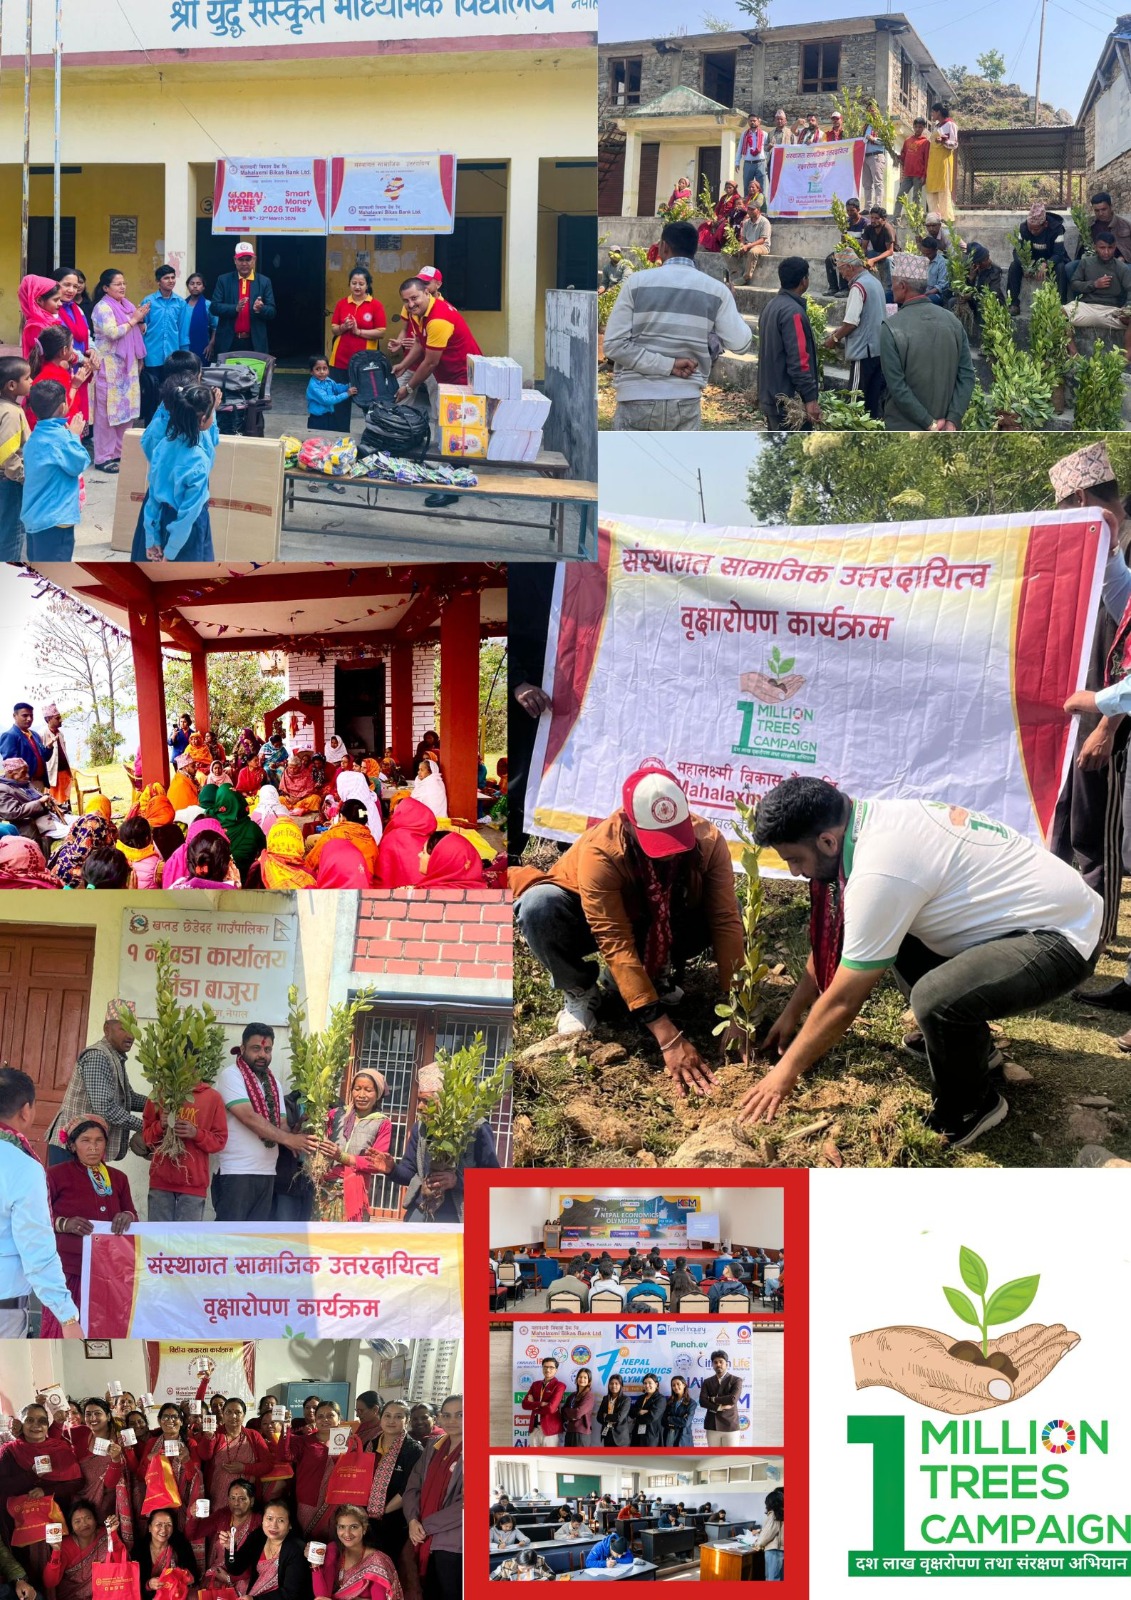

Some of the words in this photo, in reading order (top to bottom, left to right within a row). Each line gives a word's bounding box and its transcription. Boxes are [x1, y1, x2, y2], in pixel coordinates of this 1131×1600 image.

[622, 543, 714, 574] संस्थागत
[720, 556, 834, 583] सामाजिक
[840, 556, 991, 593] उत्तरदायित्व
[680, 600, 778, 640] वृक्षारोपण
[786, 606, 894, 641] कार्यक्रम
[736, 700, 754, 750] 1
[757, 704, 814, 721] MILLION
[757, 719, 800, 735] TREES
[753, 735, 818, 753] CAMPAIGN
[677, 761, 733, 781] महालक्ष्मी
[740, 765, 784, 787] विकास
[676, 779, 768, 806] Mahalaxm
[152, 920, 179, 932] खप्तड
[217, 920, 269, 935] गाउँपालिका
[127, 943, 139, 962] १
[168, 945, 203, 965] वडा
[206, 944, 288, 970] कार्यालय
[205, 980, 260, 1006] बाजुरा
[677, 1198, 697, 1208] KCM
[147, 1251, 229, 1275] संस्थागत
[234, 1251, 322, 1275] सामाजिक
[328, 1250, 441, 1279] उत्तरदायित्व
[203, 1291, 291, 1324] वृक्षारोपण
[297, 1293, 381, 1319] कार्यक्रम
[616, 1324, 652, 1339] KCM
[733, 1358, 750, 1367] Life
